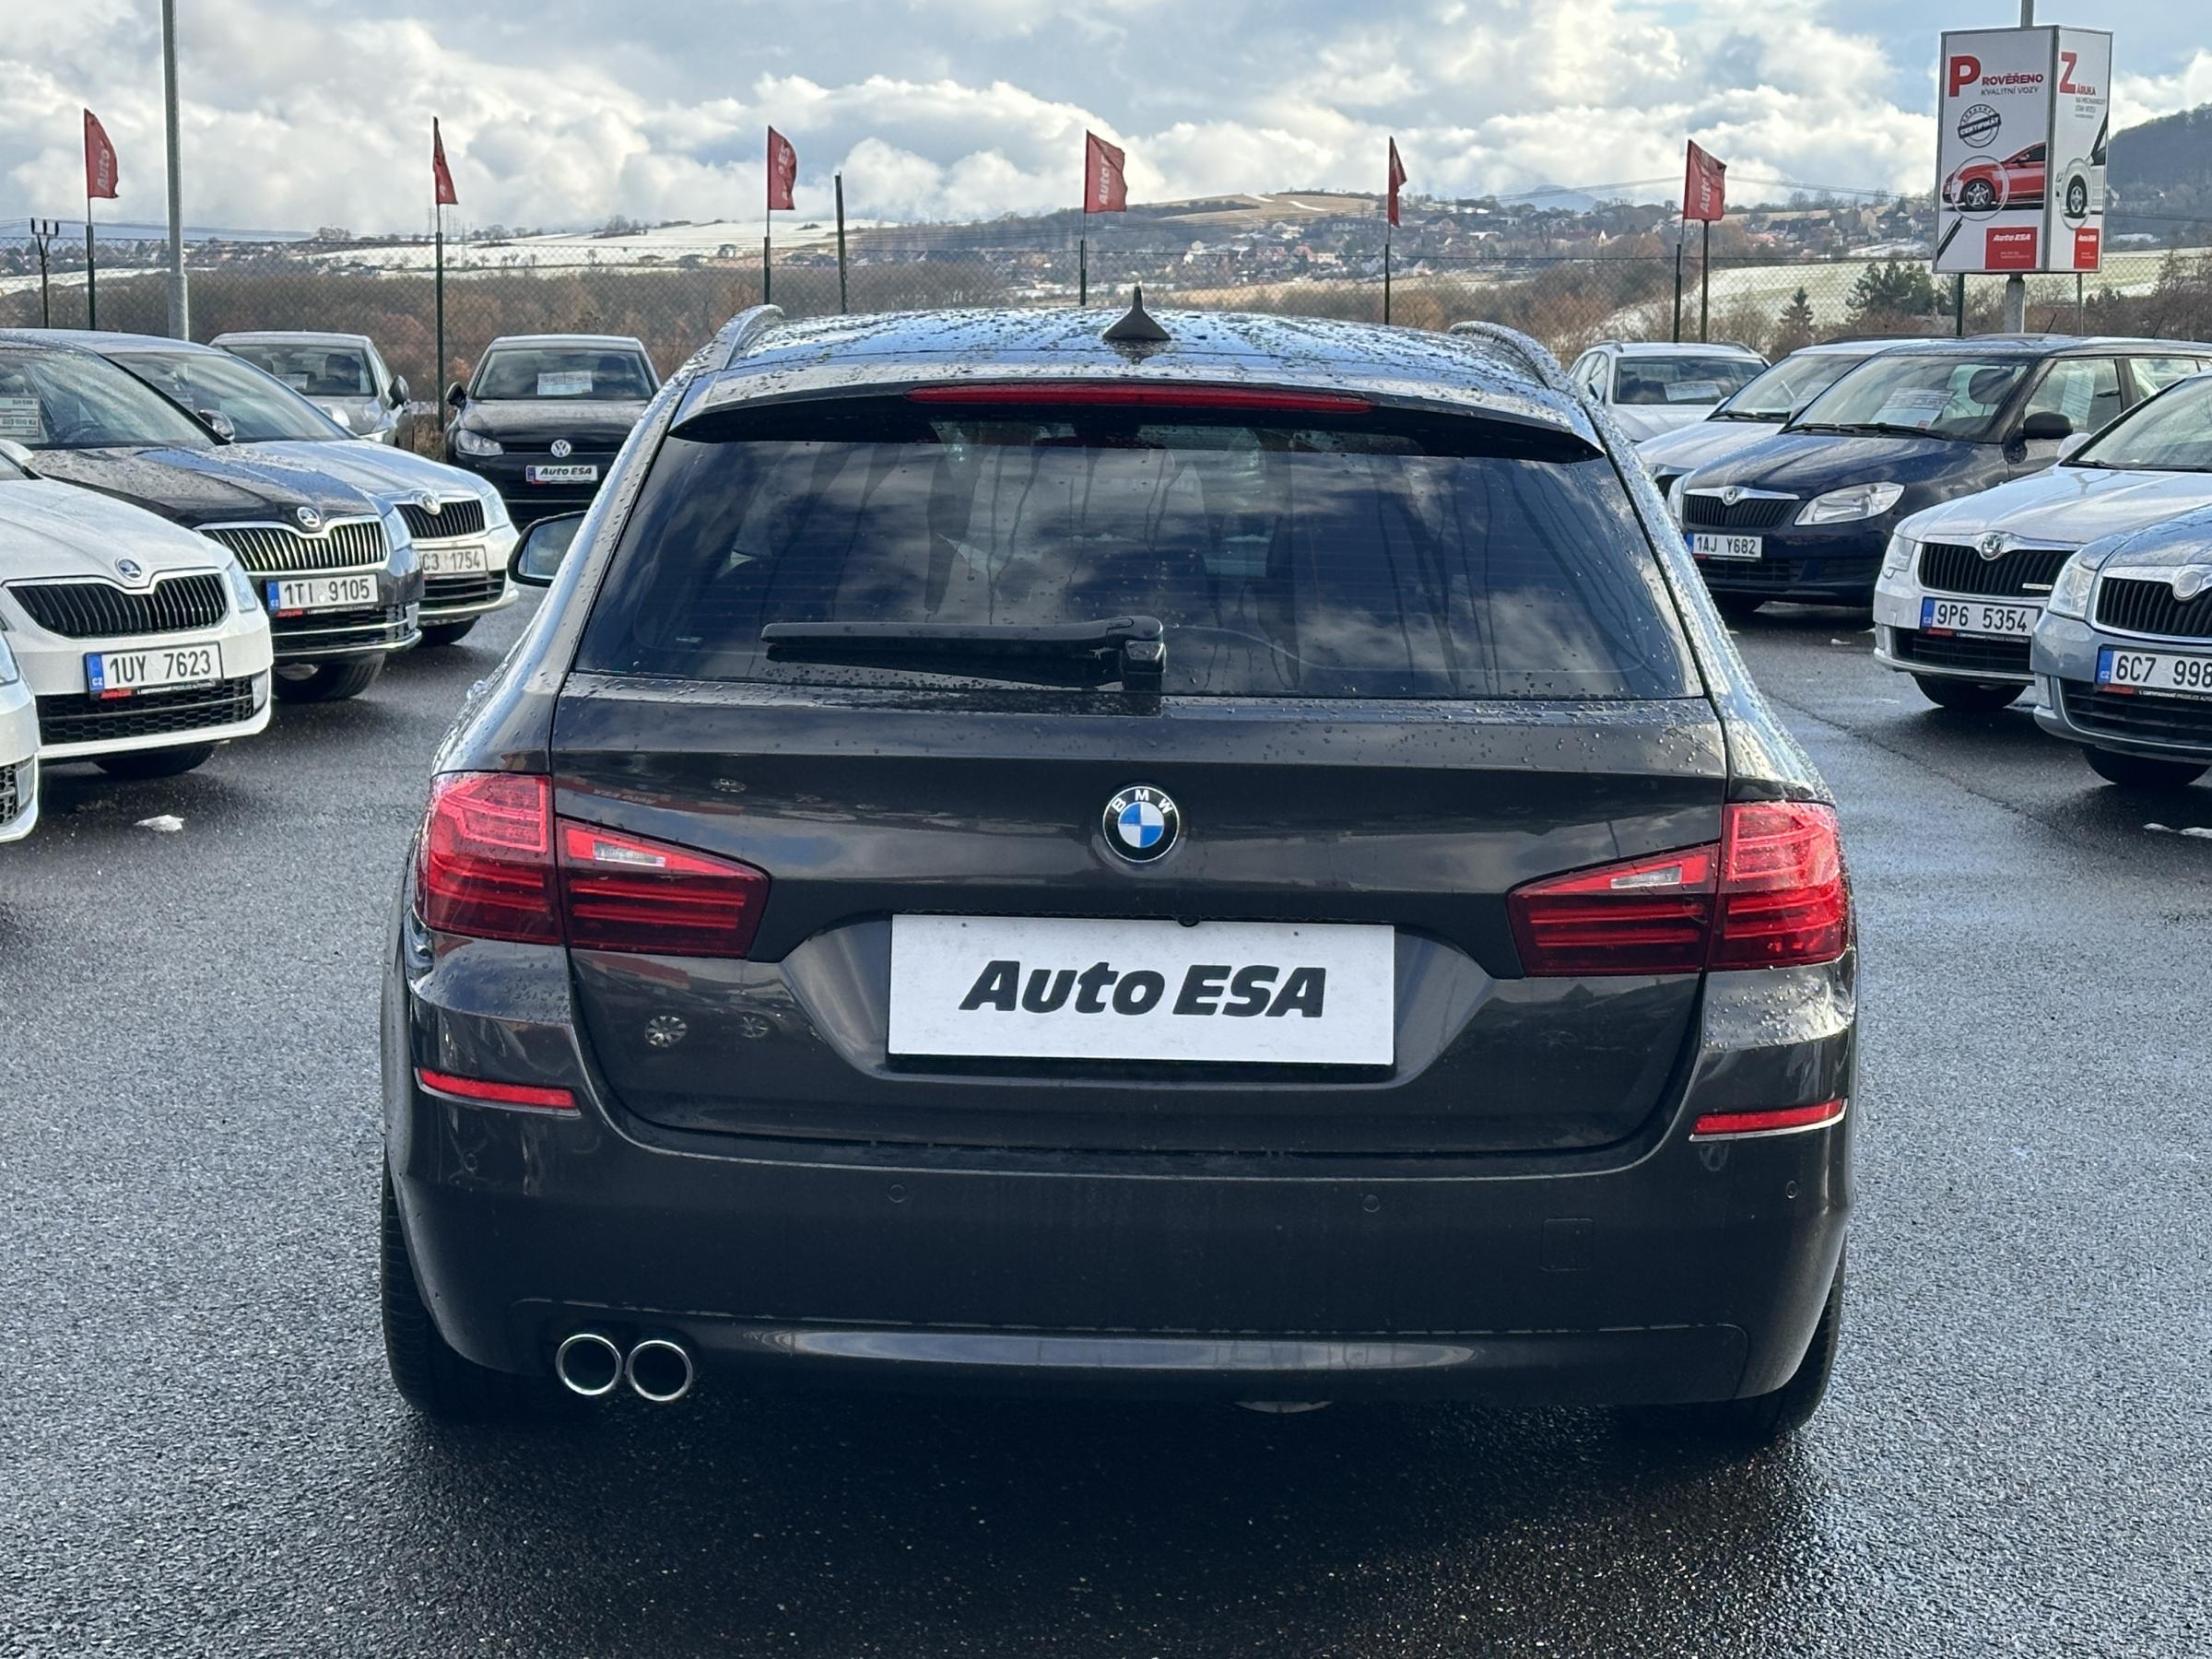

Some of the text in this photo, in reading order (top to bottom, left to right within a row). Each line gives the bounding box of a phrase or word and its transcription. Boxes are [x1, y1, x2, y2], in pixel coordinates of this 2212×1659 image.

[1981, 86, 2040, 96] KVALITNÍ VOZY
[540, 467, 593, 476] Auto ESA
[1697, 535, 1756, 555] 1AJ Y682
[419, 550, 480, 571] C3 1754
[328, 578, 370, 602] 9105
[1936, 604, 1970, 627] 9P6
[1983, 607, 2028, 632] 5354
[92, 649, 211, 687] CZ 1UY 7623
[2115, 654, 2157, 683] 6C7
[1111, 789, 1174, 814] BMW
[959, 959, 1327, 1018] Auto ESA
